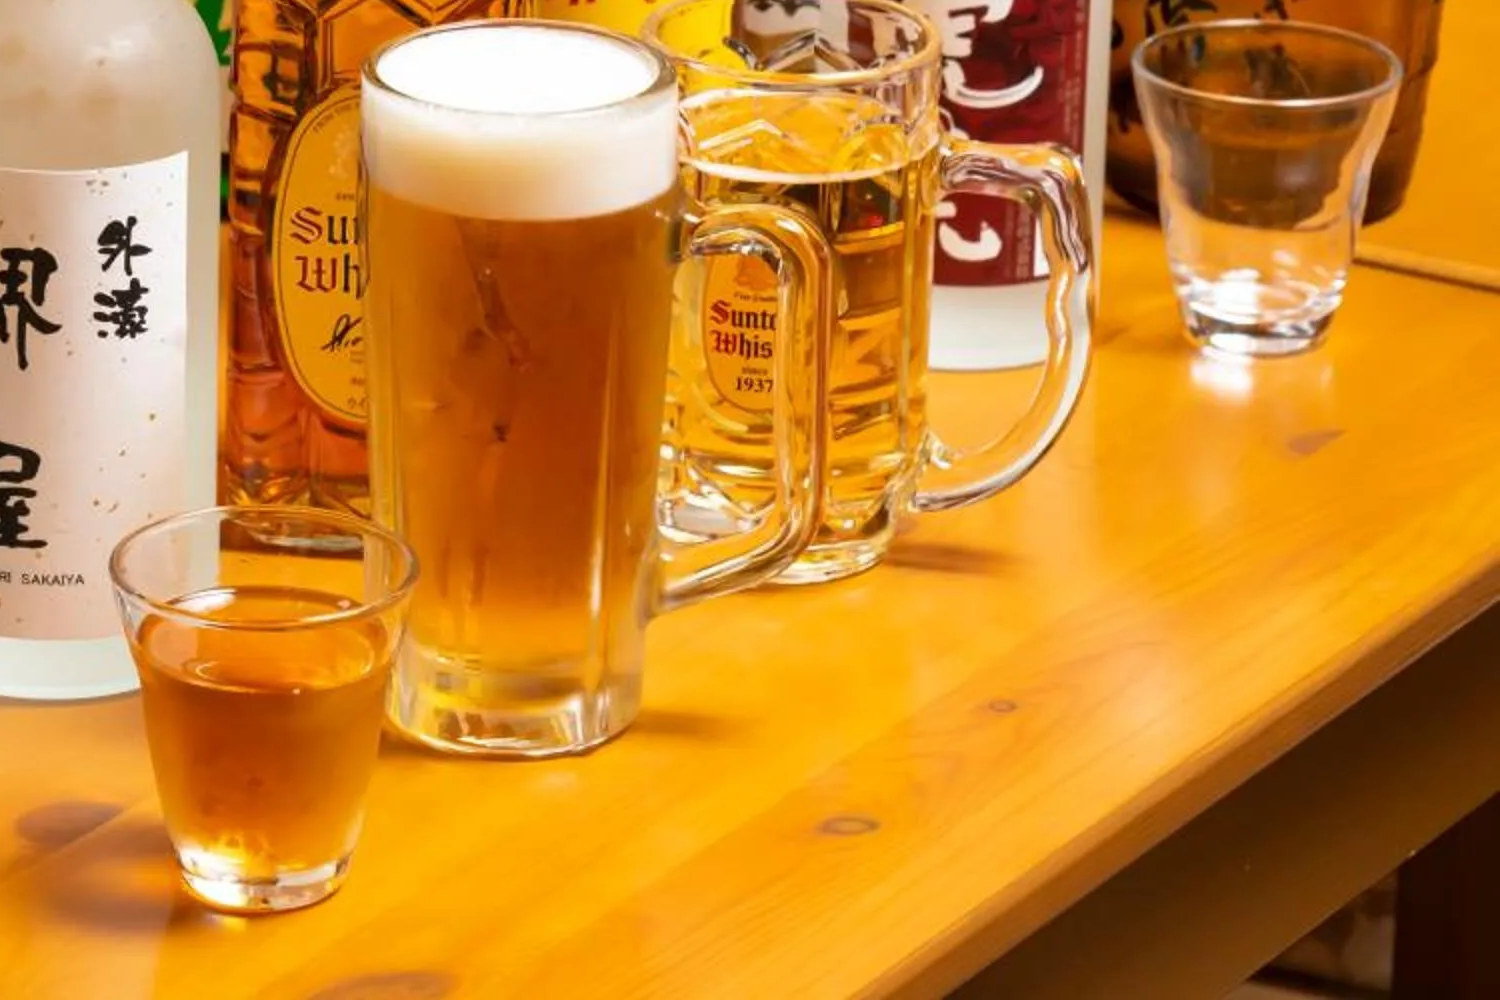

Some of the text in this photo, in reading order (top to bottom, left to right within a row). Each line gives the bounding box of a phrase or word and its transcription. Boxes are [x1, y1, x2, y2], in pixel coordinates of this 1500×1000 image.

[708, 329, 774, 361] Whis
[735, 376, 774, 393] 1937
[21, 572, 85, 587] SAKAIYA
